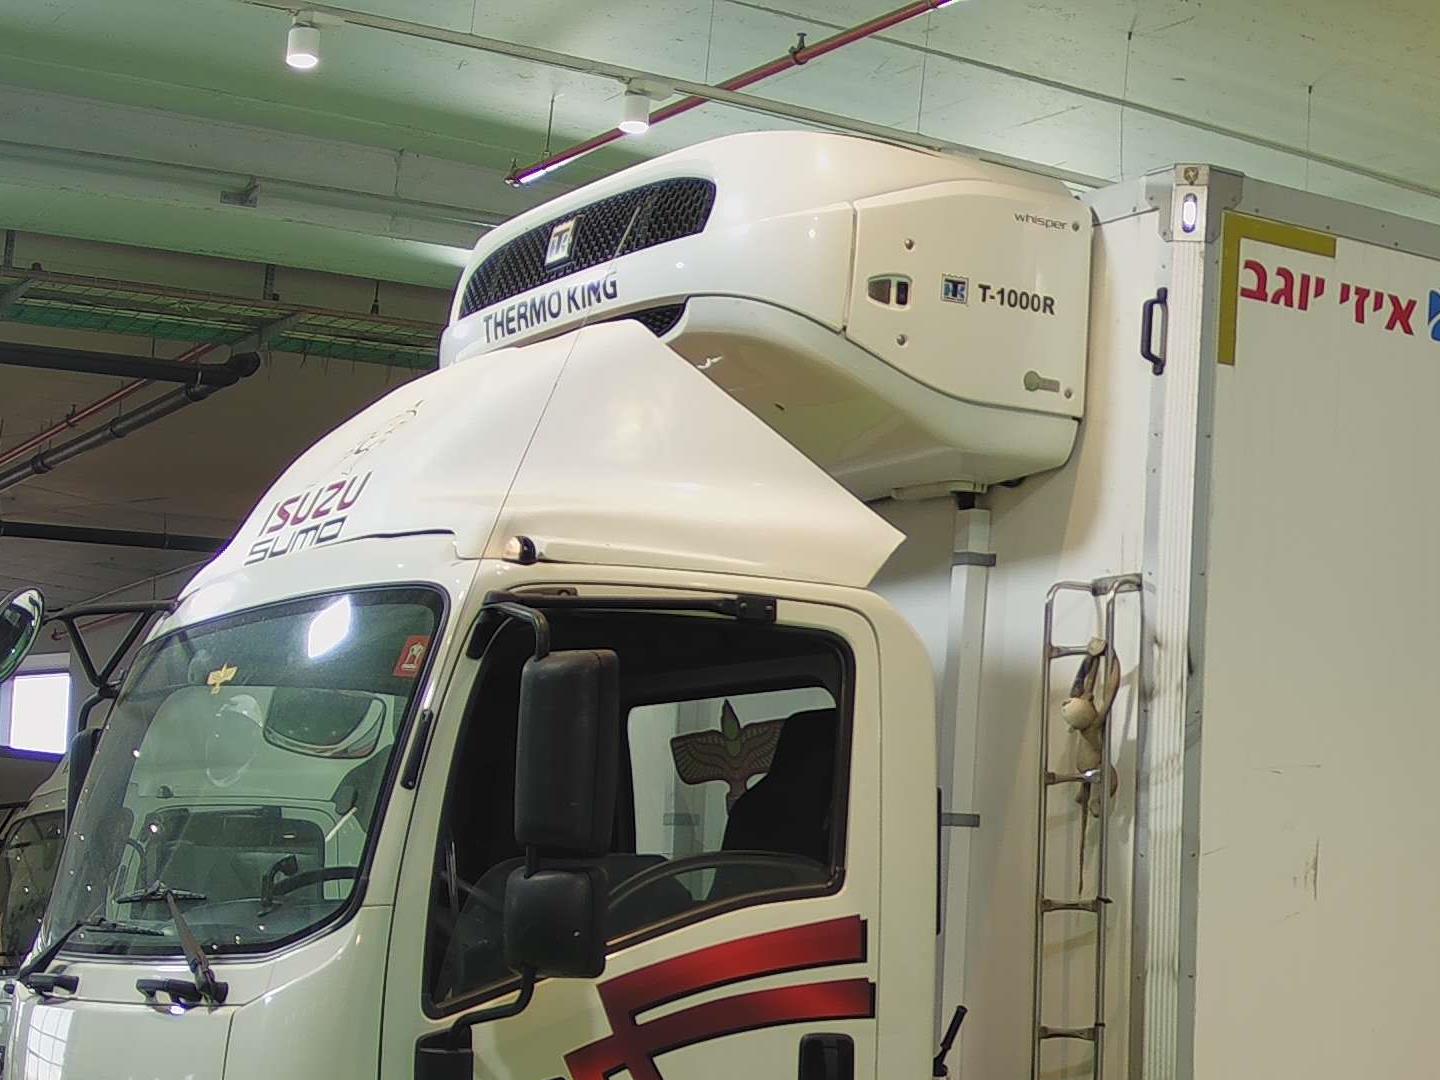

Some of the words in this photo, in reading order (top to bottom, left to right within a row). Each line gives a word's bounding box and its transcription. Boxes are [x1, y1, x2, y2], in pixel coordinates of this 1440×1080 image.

[1014, 212, 1067, 230] whisper
[484, 290, 562, 343] THERMO
[567, 271, 618, 314] KING
[978, 284, 1055, 315] T-1000R
[1240, 259, 1325, 312] יוגב
[1339, 282, 1418, 336] איזי
[259, 471, 373, 537] ISUZU
[244, 515, 348, 566] SUMO
